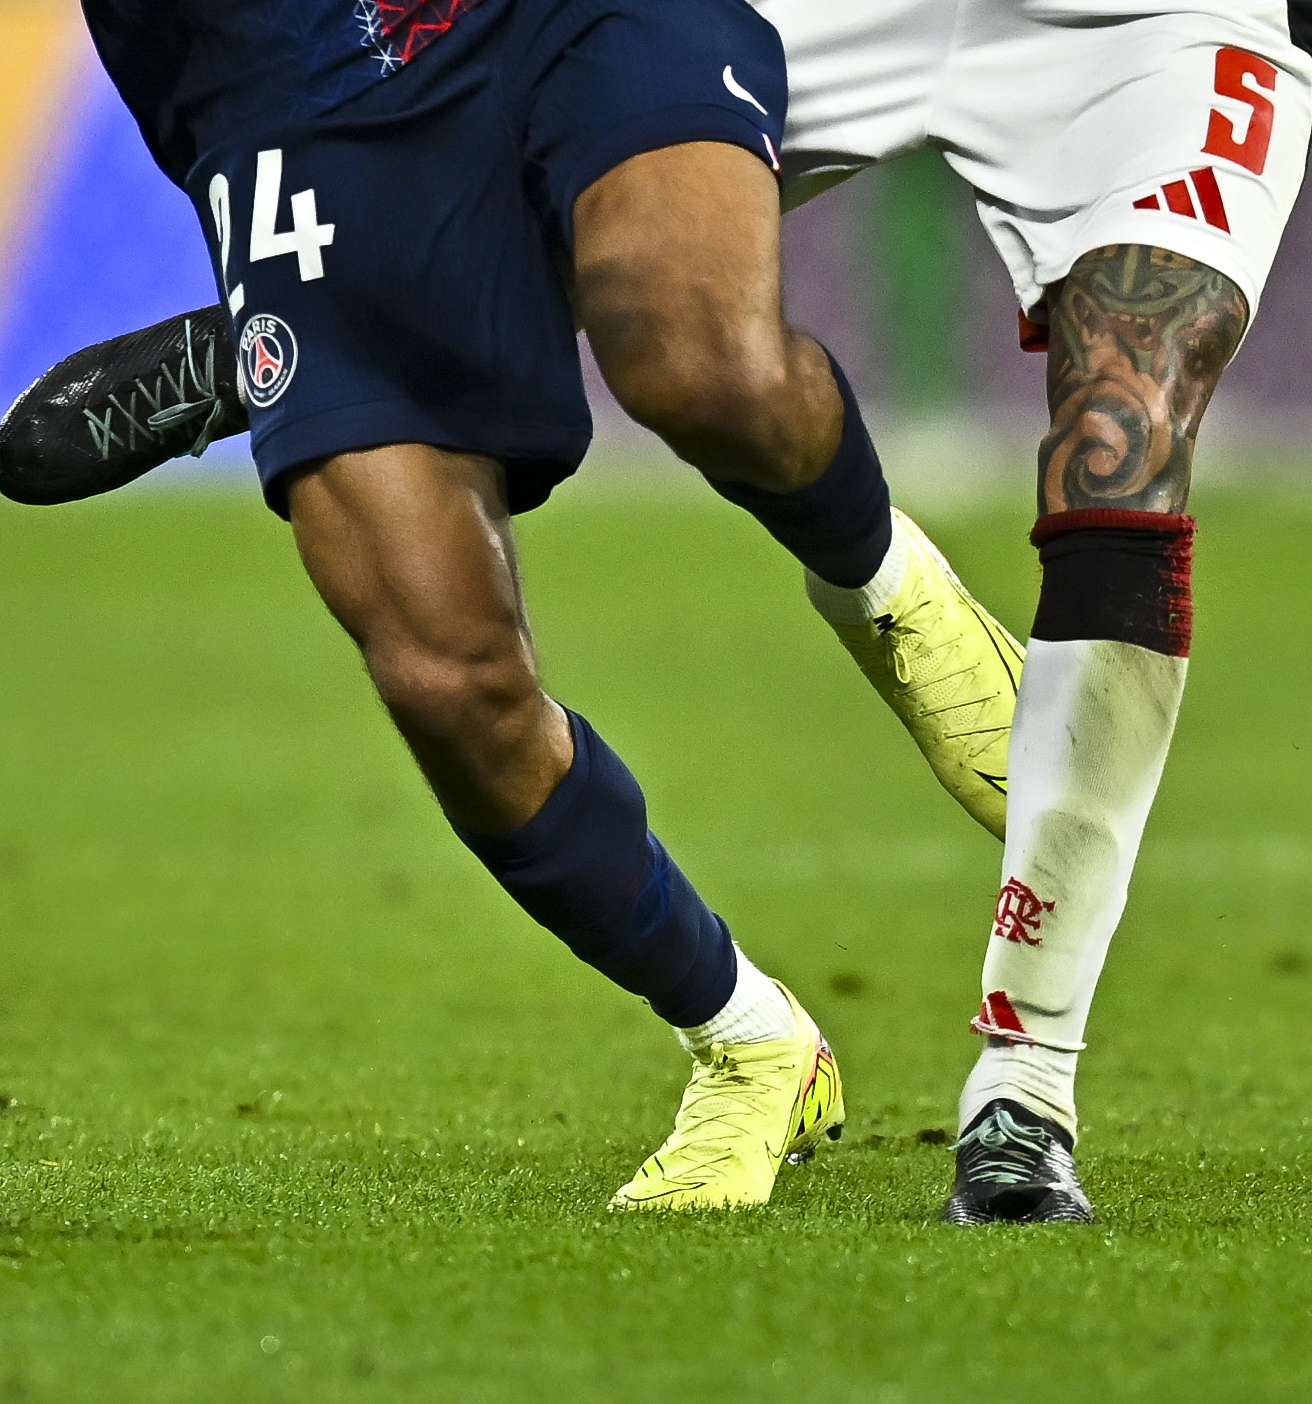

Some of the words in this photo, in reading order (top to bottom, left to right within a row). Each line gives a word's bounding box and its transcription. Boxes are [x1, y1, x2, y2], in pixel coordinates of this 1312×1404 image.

[1200, 47, 1279, 176] 5
[208, 148, 335, 319] 24
[242, 318, 279, 352] PARIS
